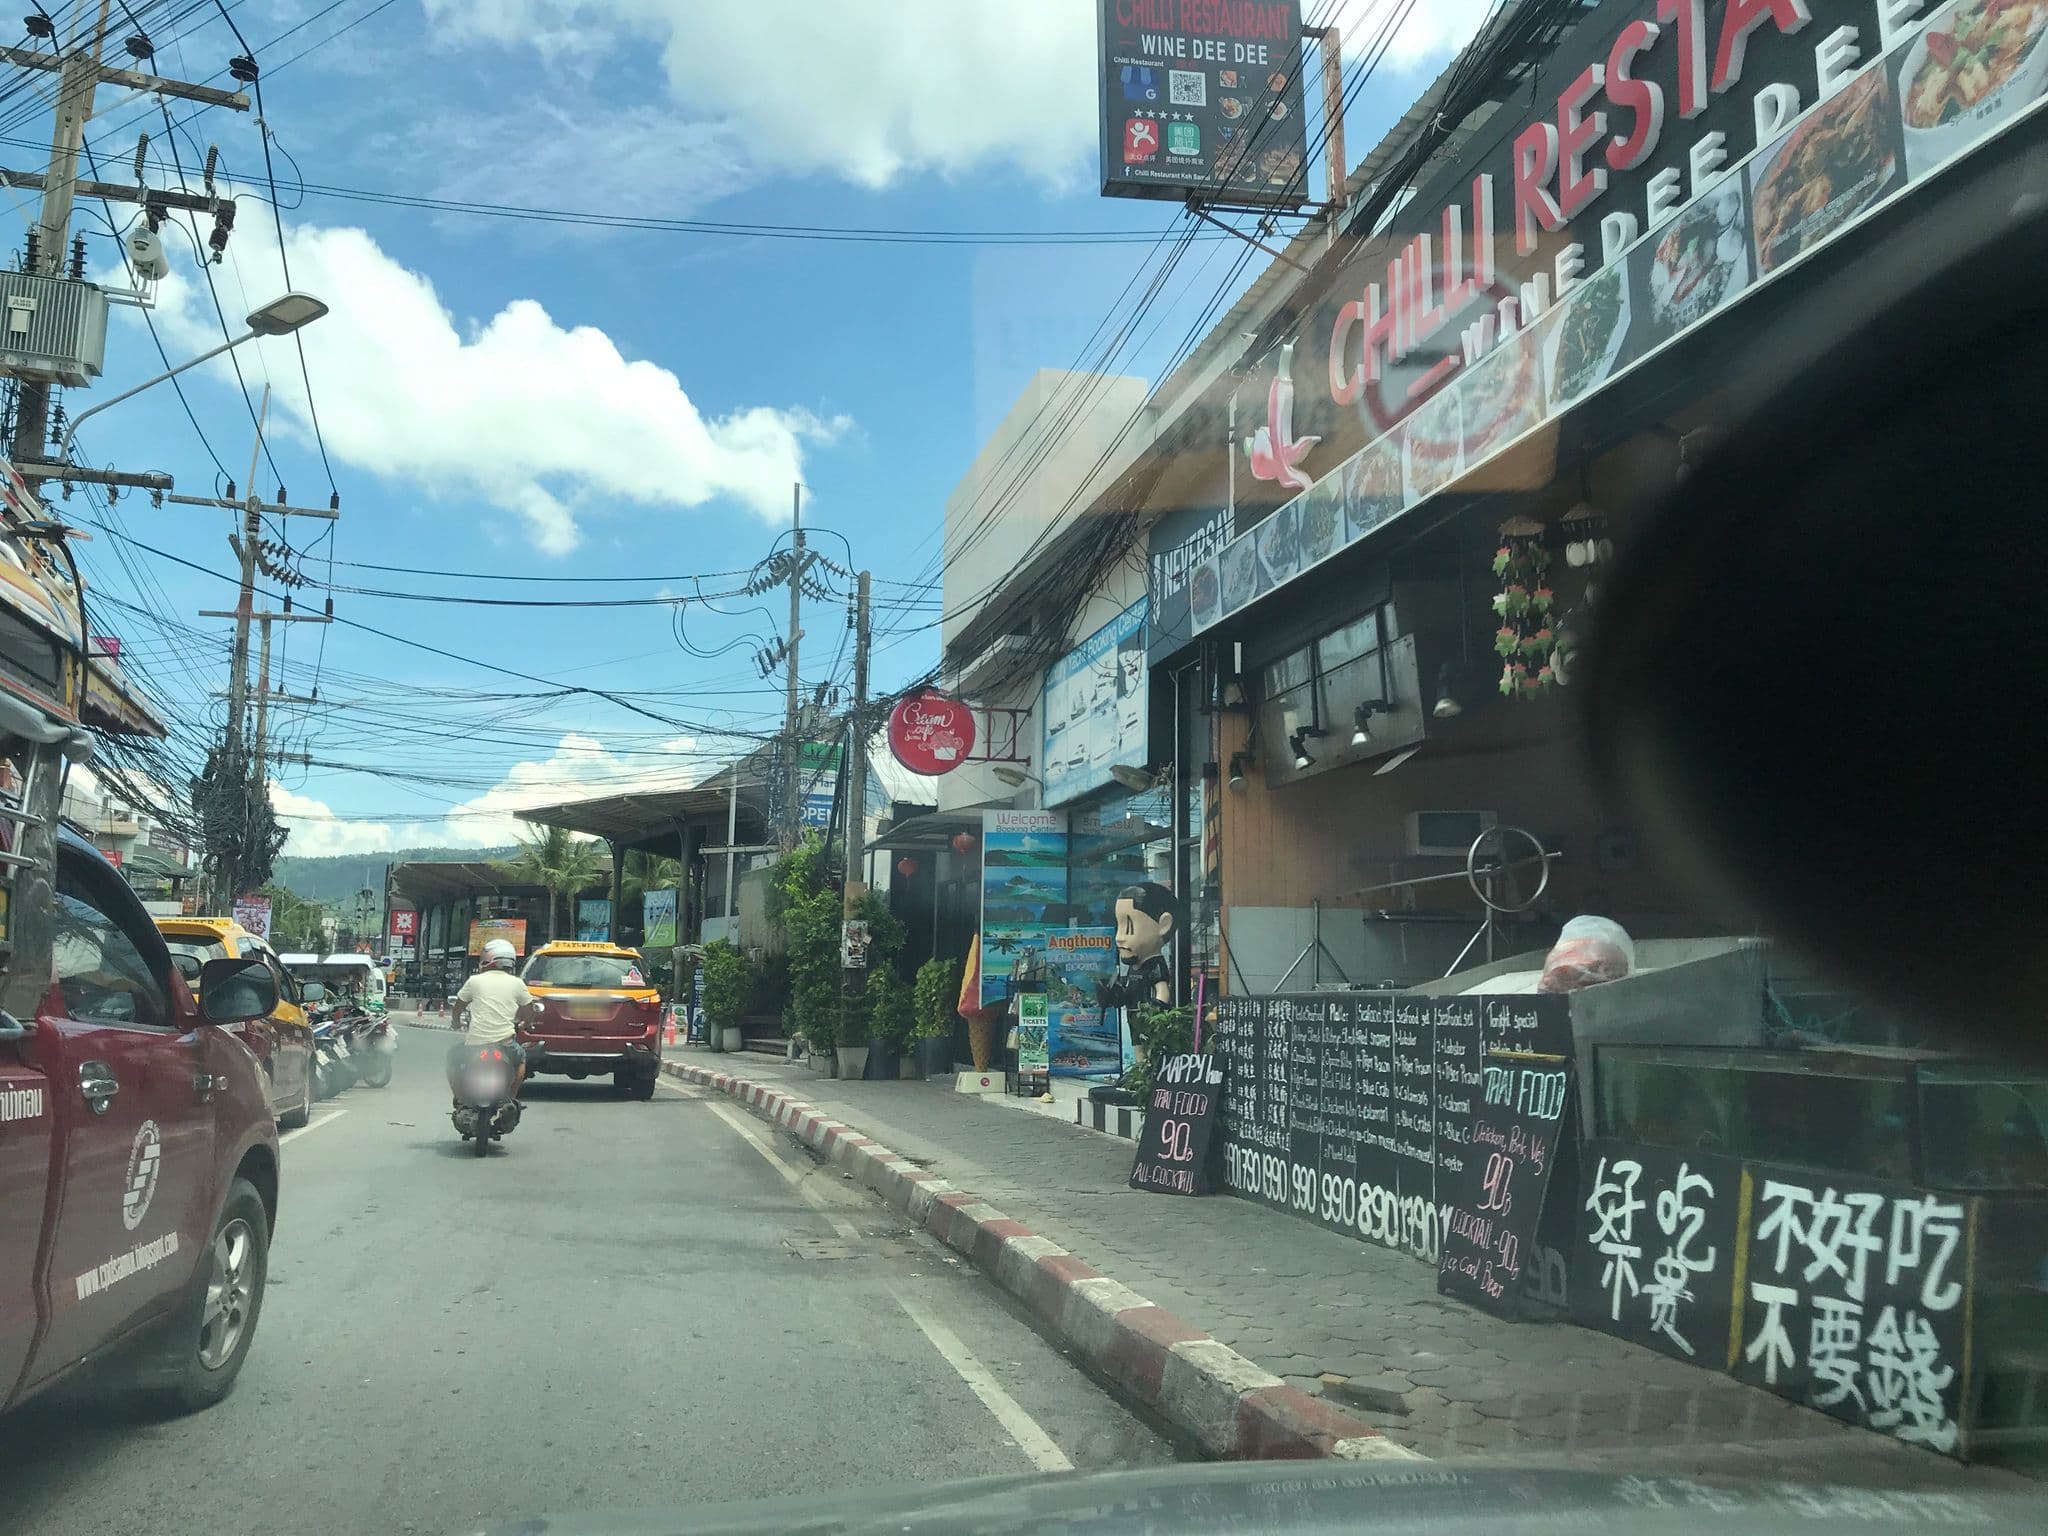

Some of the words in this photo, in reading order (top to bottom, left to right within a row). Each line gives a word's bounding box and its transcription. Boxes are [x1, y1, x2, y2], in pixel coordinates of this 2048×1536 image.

[1116, 0, 1174, 31] CHILLI
[1181, 0, 1290, 40] RESTAURANT
[1130, 58, 1164, 67] Restaurant
[1141, 34, 1186, 58] WINE
[1193, 39, 1226, 62] DEE
[1234, 43, 1268, 65] DEE
[1150, 170, 1180, 179] Restaurant
[1461, 243, 1585, 367] WINE
[1601, 131, 1728, 268] DEE
[1329, 173, 1494, 406] CHILLI
[996, 812, 1057, 825] Welcome
[1048, 934, 1113, 951] Angthong
[1157, 1053, 1206, 1084] HAPPY
[1483, 1067, 1515, 1106] THAI
[1517, 1070, 1567, 1120] FOOD
[1173, 1091, 1208, 1116] FOOD
[1238, 1147, 1260, 1193] 1790
[1262, 1153, 1287, 1203] 1990
[1292, 1163, 1316, 1214] 990
[1321, 1173, 1355, 1226] 990
[1358, 1182, 1399, 1247] 890
[1586, 1157, 1716, 1272] 好吃
[1400, 1195, 1438, 1265] 1790
[1757, 1178, 1964, 1311] 不好吃
